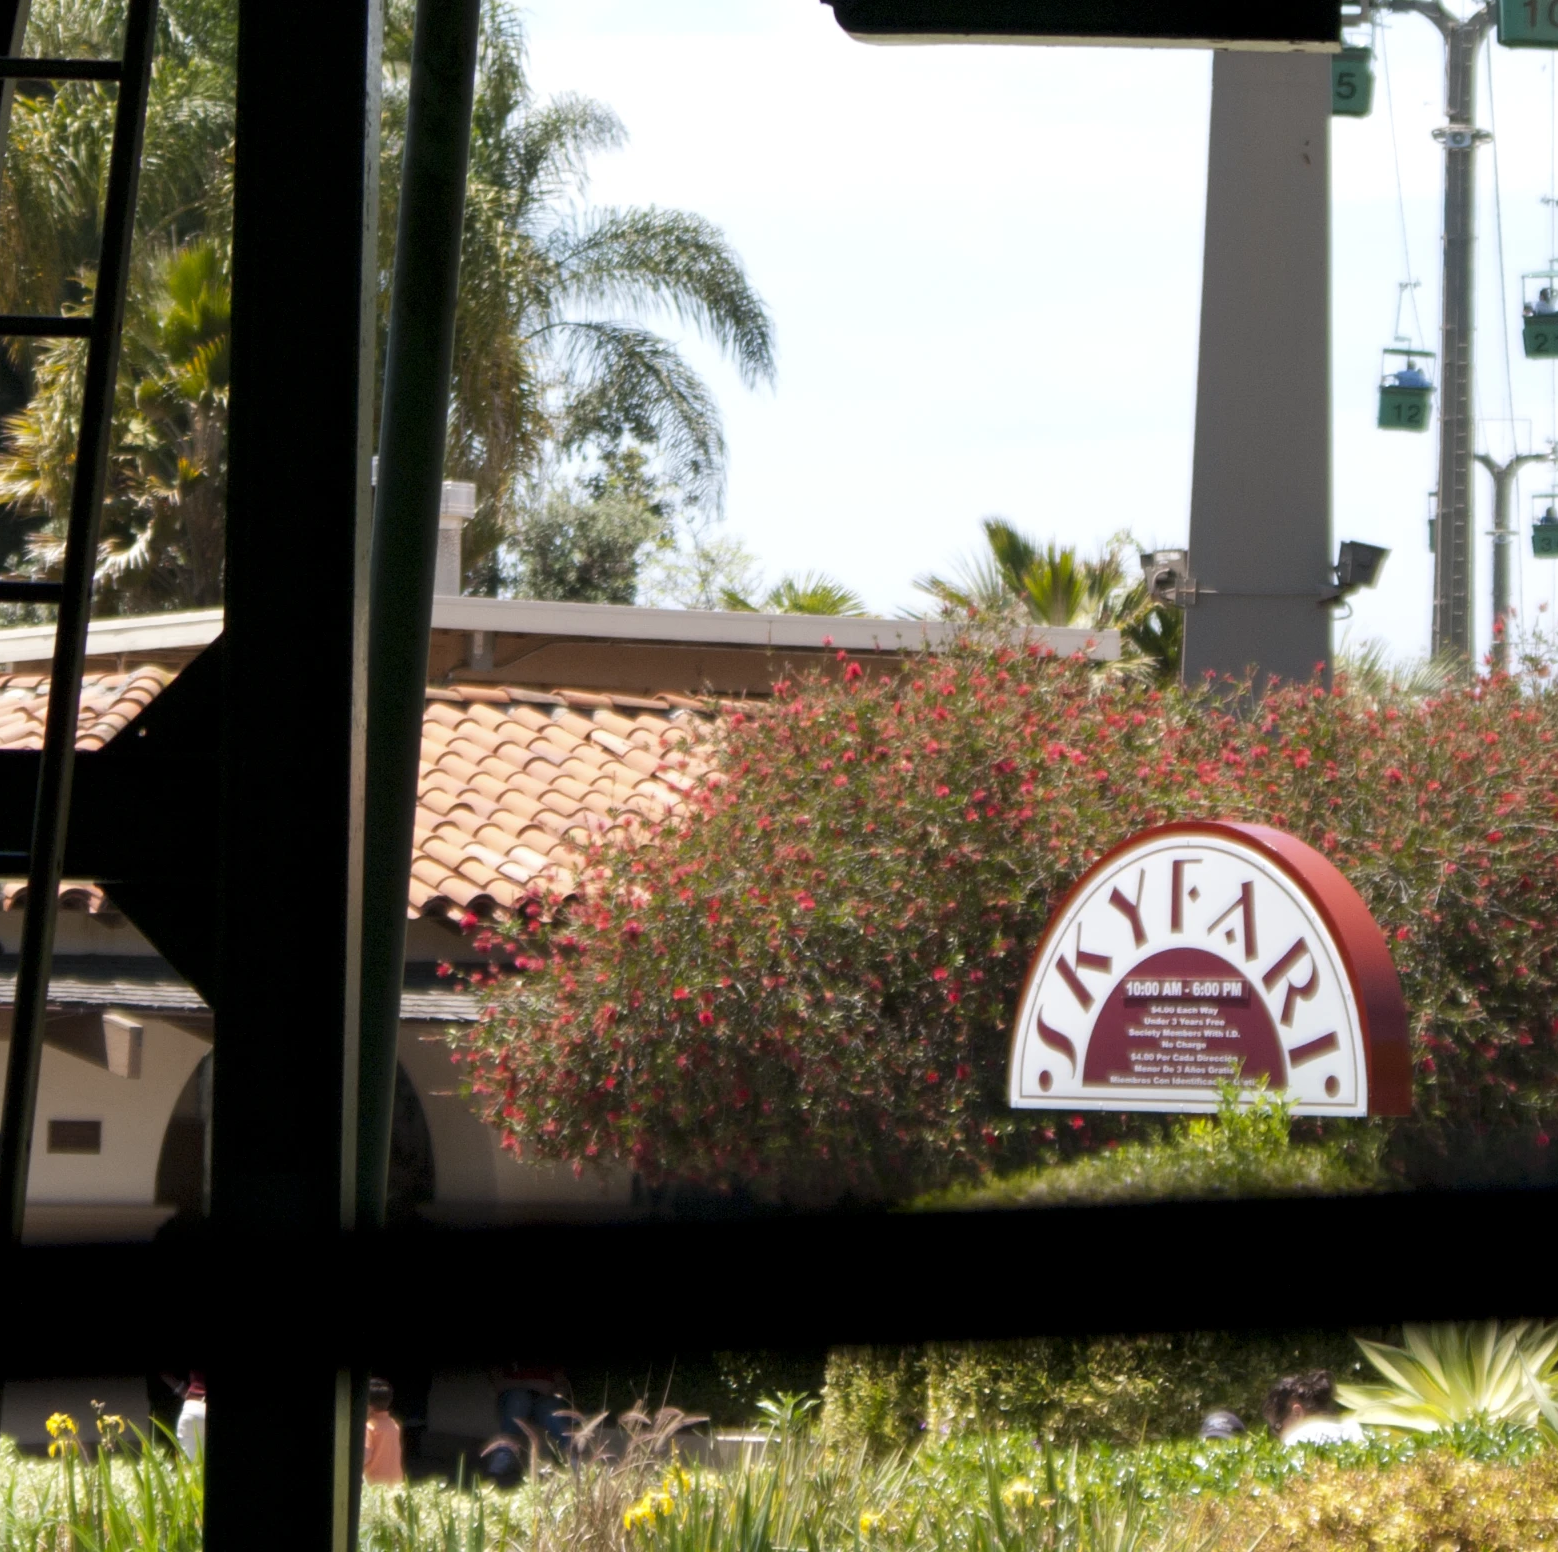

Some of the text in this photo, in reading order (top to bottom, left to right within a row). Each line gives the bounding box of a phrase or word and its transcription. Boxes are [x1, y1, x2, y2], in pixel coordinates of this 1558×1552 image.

[1334, 71, 1358, 101] 5
[1393, 403, 1422, 425] 12
[1036, 858, 1340, 1080] SKYFARI
[1126, 981, 1159, 997] 10:00
[1162, 981, 1182, 997] AM
[1192, 981, 1219, 997] 6:00
[1222, 981, 1242, 997] PM
[1176, 1005, 1198, 1015] Each
[1200, 1005, 1219, 1017] Way
[1143, 1017, 1226, 1027] Under 3 Years Free
[1128, 1028, 1161, 1039] Society
[1162, 1028, 1202, 1038] Members
[1203, 1028, 1224, 1038] With
[1161, 1040, 1207, 1051] No Charge
[1172, 1053, 1195, 1062] Cada
[1162, 1065, 1175, 1074] De
